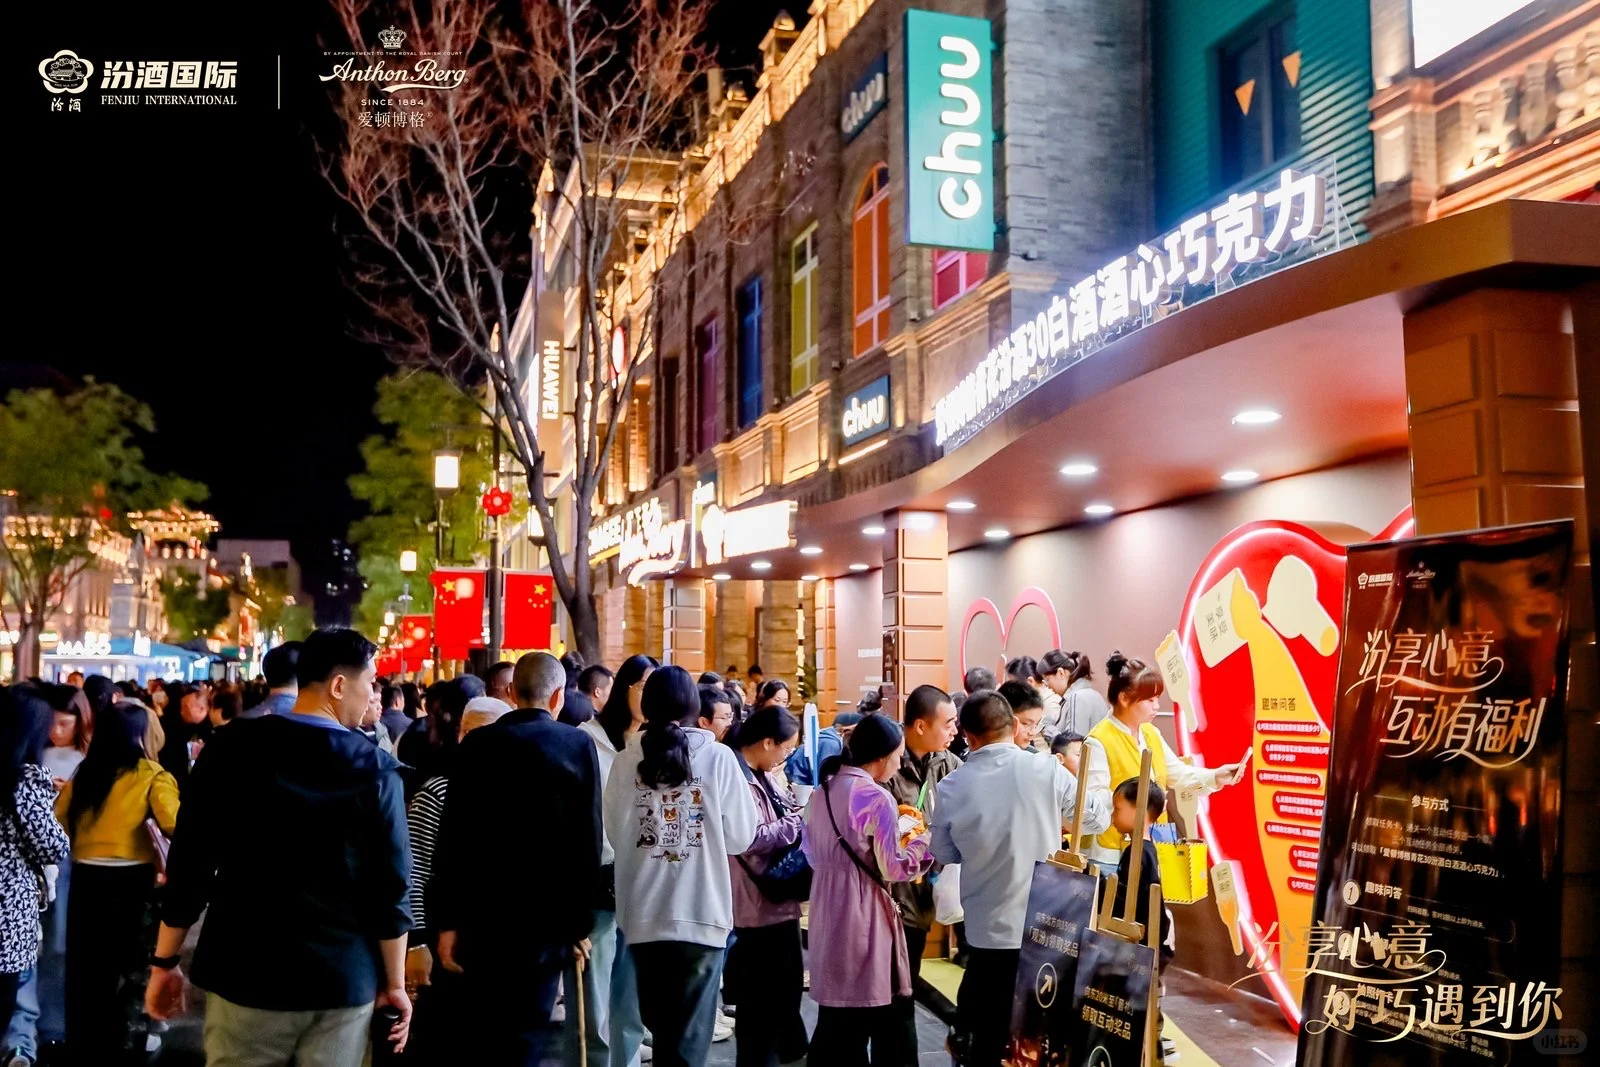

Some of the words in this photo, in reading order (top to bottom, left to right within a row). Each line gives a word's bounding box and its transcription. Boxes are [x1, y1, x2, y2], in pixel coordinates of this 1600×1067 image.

[841, 72, 884, 134] chuu
[924, 35, 982, 219] chuu
[542, 340, 560, 420] HUAWEI
[842, 394, 886, 438] chuu
[1380, 695, 1546, 767] 互动有福利
[1412, 794, 1449, 812] 参与方式
[1365, 881, 1402, 900] 趣味问答
[1082, 1004, 1131, 1041] 领取互动奖品
